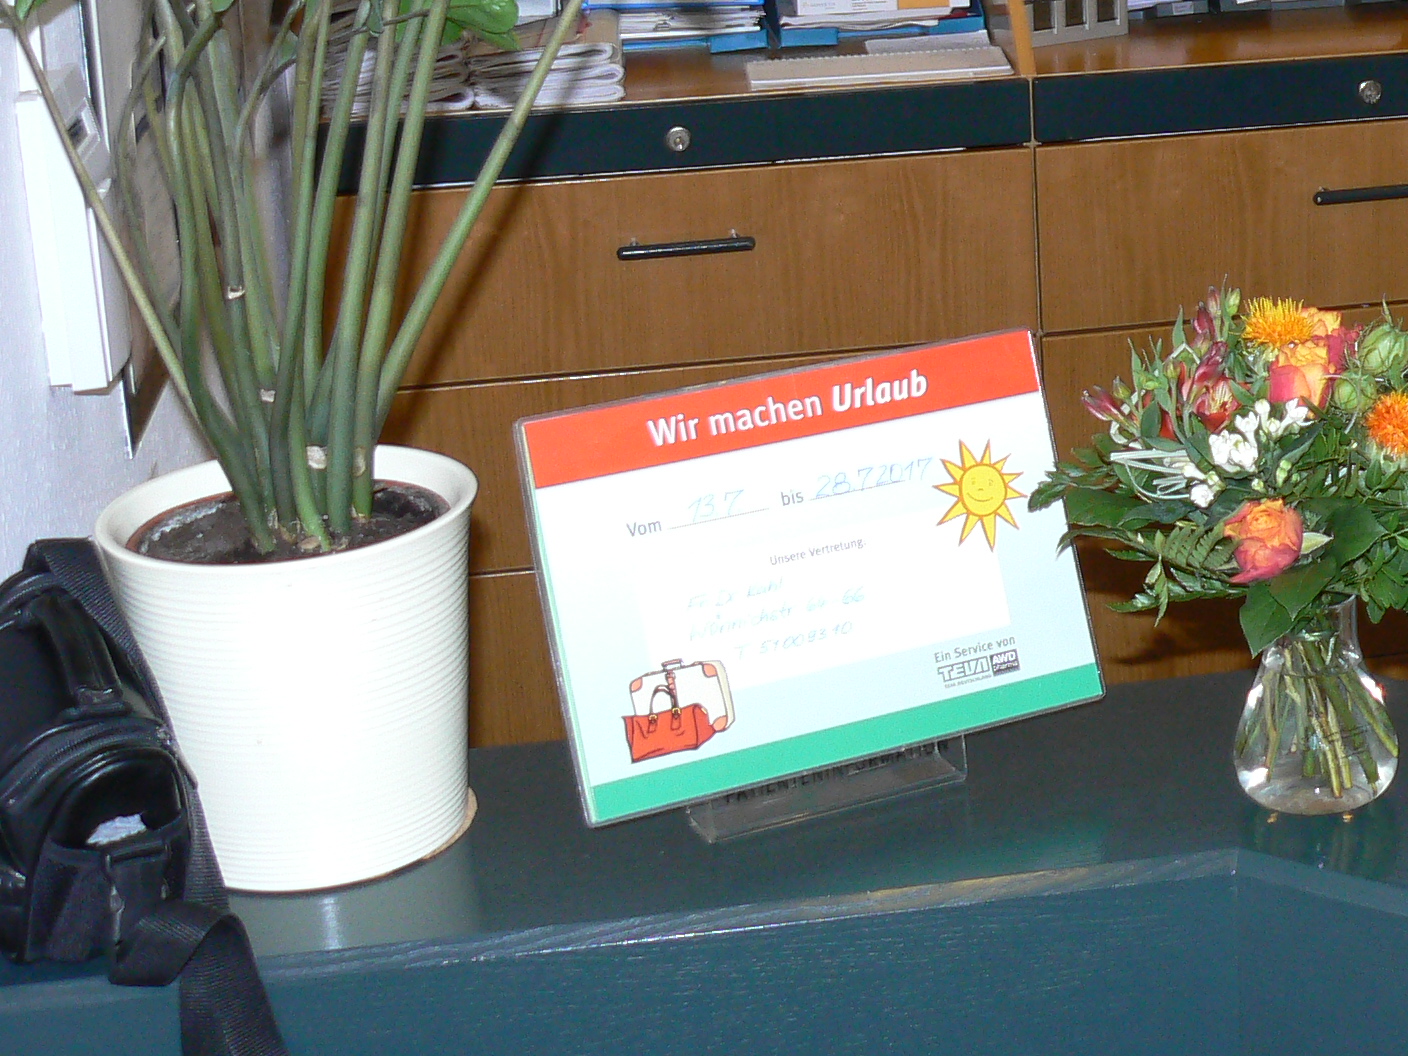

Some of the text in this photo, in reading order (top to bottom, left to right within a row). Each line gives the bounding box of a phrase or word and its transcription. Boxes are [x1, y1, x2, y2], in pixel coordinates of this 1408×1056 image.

[646, 368, 929, 447] Wir machen Urlaub
[780, 491, 805, 507] bis
[626, 520, 663, 538] Vom
[769, 549, 807, 566] Unsere
[934, 636, 1016, 663] Ein Service von
[992, 651, 1016, 665] AWD
[937, 655, 991, 682] TEVA
